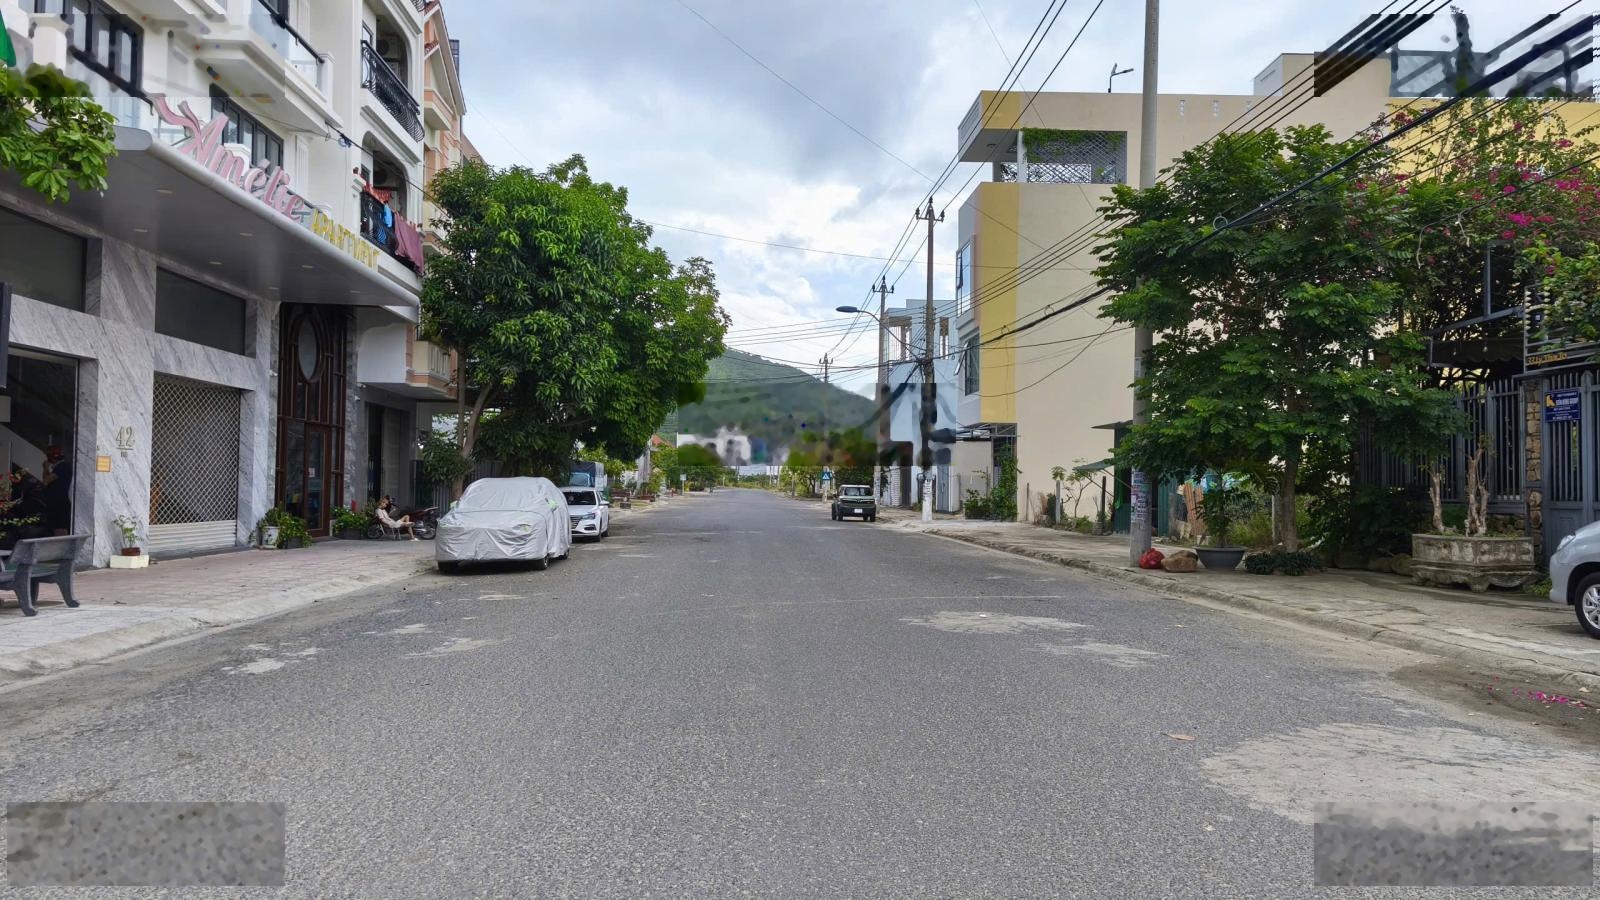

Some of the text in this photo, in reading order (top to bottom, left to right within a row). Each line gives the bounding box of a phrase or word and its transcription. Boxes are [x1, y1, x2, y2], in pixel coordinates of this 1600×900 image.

[152, 97, 305, 222] Amélie
[311, 208, 379, 270] APARTMENT
[115, 426, 135, 447] 42
